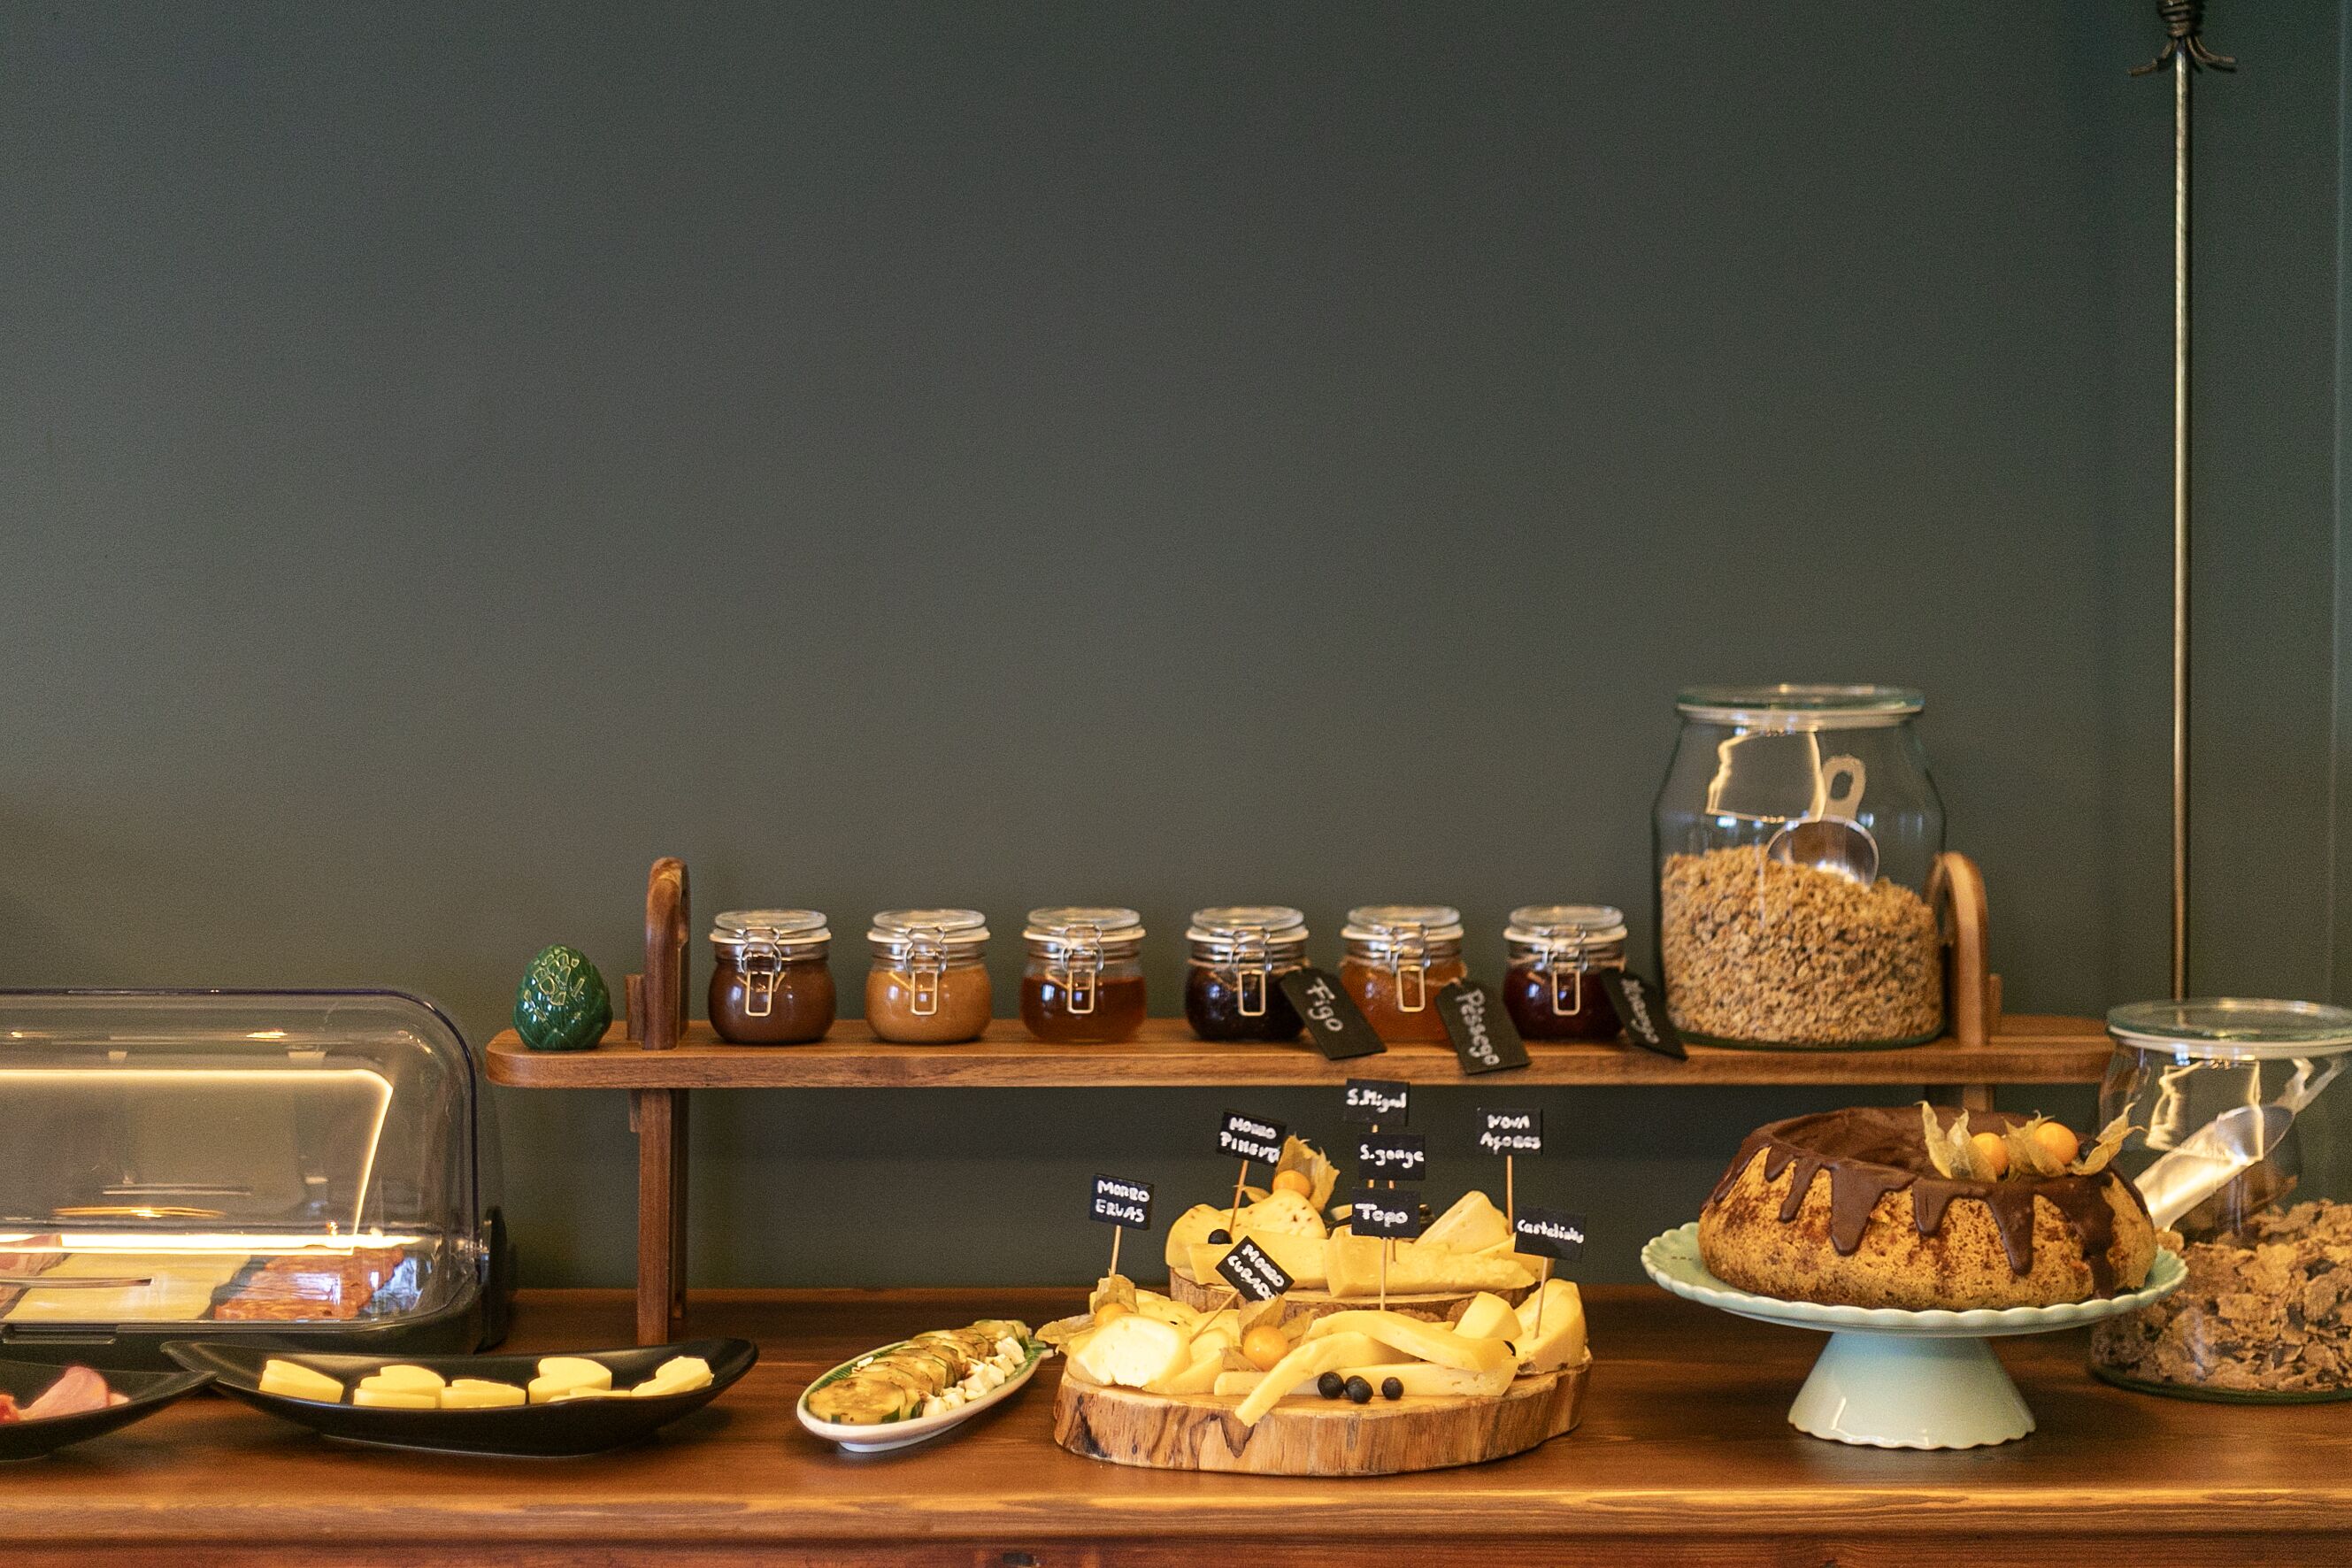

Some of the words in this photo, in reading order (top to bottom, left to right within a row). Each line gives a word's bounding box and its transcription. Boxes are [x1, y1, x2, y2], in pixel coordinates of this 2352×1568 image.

[1306, 977, 1343, 1031] Figo
[1097, 1180, 1150, 1203] MORRO
[1095, 1198, 1145, 1223] ERVAS
[1355, 1203, 1409, 1228] Topo
